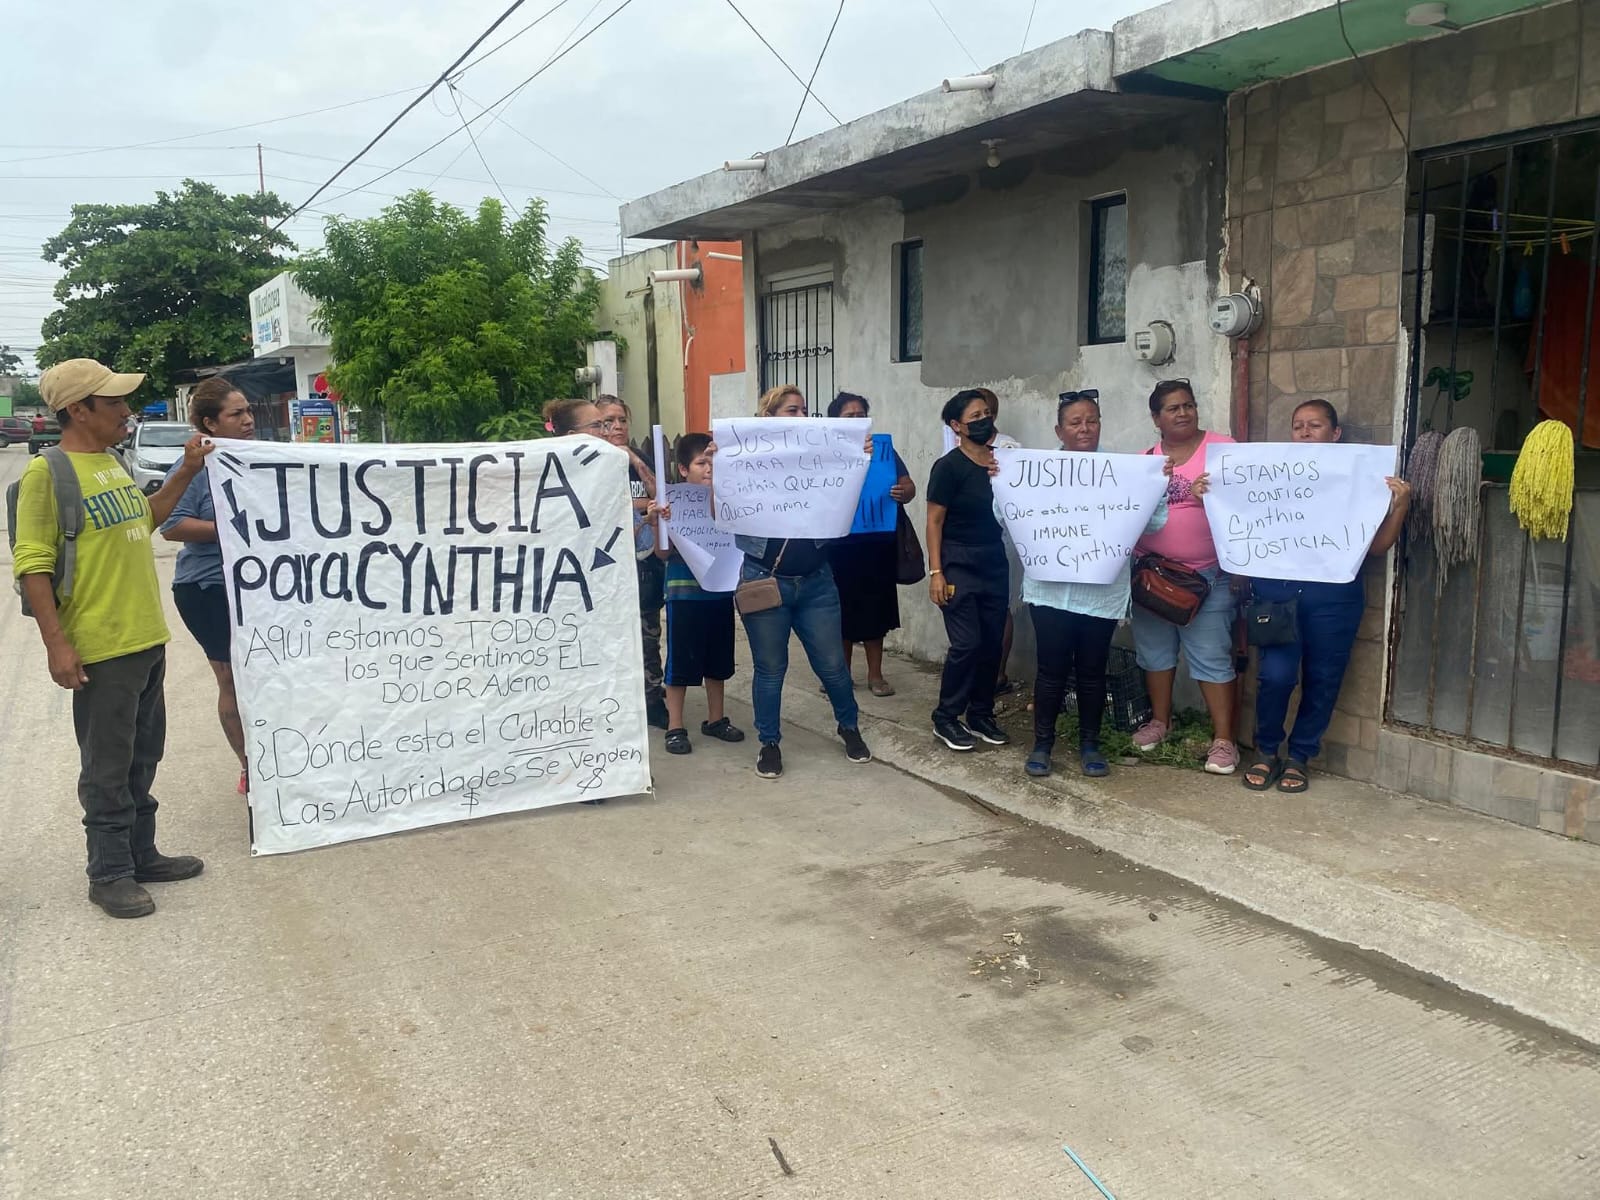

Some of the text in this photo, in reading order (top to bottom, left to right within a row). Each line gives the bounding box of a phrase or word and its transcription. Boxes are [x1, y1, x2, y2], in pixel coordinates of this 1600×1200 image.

[798, 455, 823, 471] LA
[1009, 457, 1118, 488] JUSTICIA
[1221, 454, 1320, 486] ESTAMOS
[823, 476, 844, 489] NO
[83, 484, 149, 531] HOLLIS
[1004, 502, 1034, 521] Que
[1097, 496, 1141, 520] quede
[1228, 507, 1305, 541] Cynthia
[1033, 523, 1092, 541] IMPUNE
[1056, 538, 1132, 574] Cynthia
[232, 541, 594, 627] para CYNTHIA
[326, 617, 444, 650] estamos
[455, 613, 580, 647] TODOS
[344, 656, 380, 682] los
[389, 653, 434, 680] que
[558, 640, 600, 671] EL
[382, 676, 477, 705] DOLOR
[395, 722, 455, 754] esta
[465, 714, 487, 745] el
[276, 787, 338, 826] Las
[342, 761, 517, 819] Autoridades
